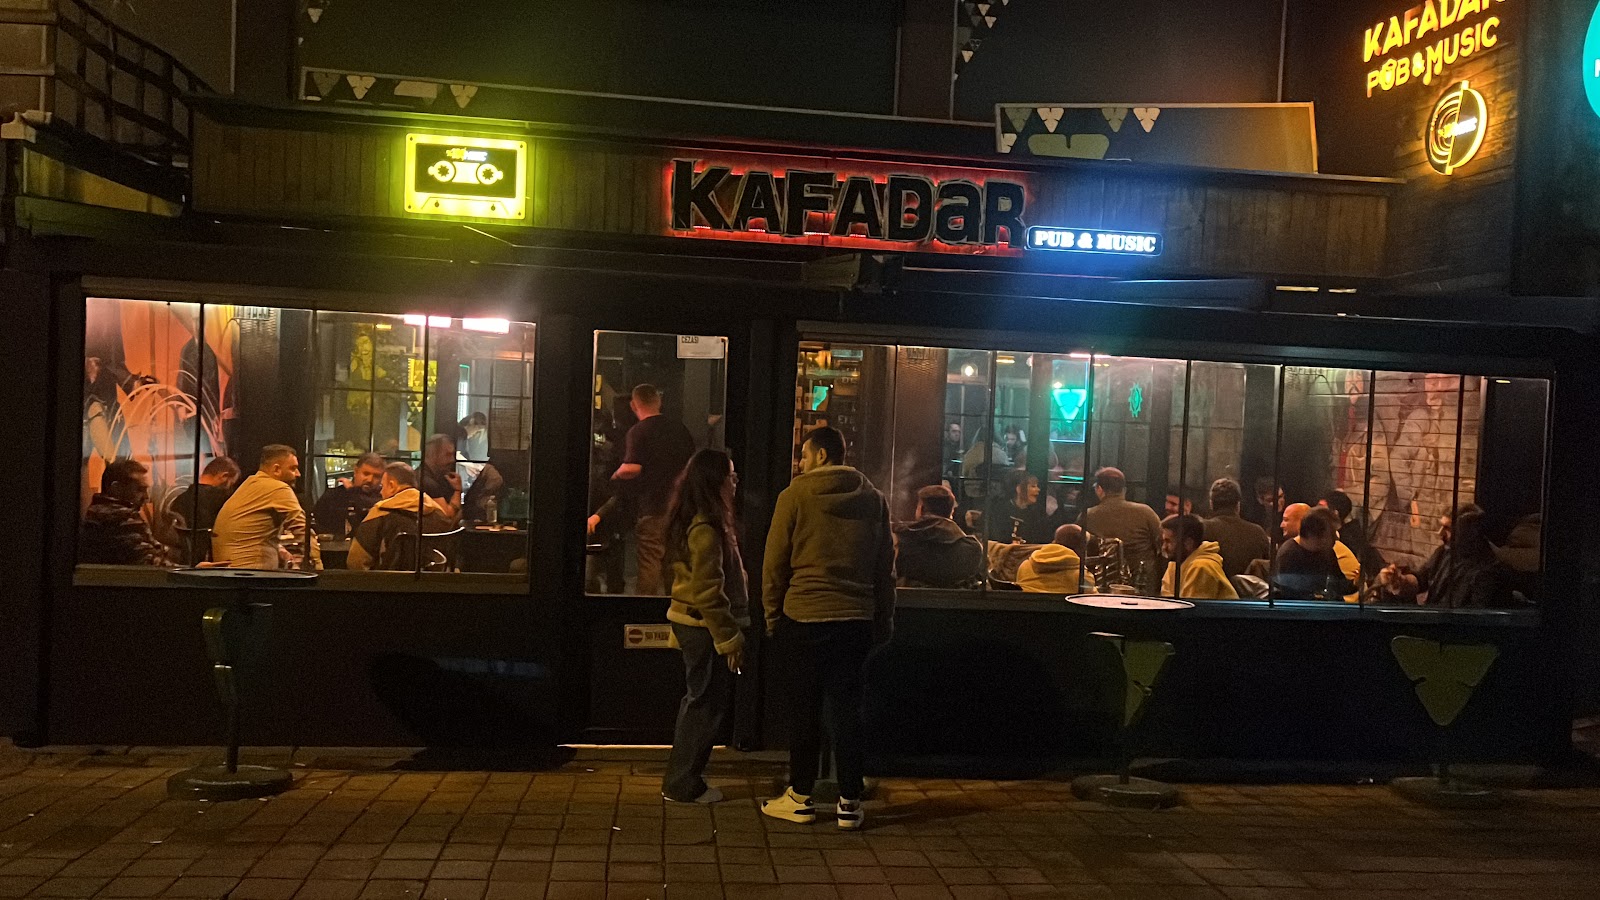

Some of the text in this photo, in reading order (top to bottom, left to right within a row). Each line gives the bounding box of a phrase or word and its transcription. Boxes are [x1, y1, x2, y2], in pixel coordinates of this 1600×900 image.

[1363, 0, 1505, 63] KAFADA
[1423, 16, 1500, 86] MUSIC
[1034, 230, 1156, 253] PUB & MUSIC
